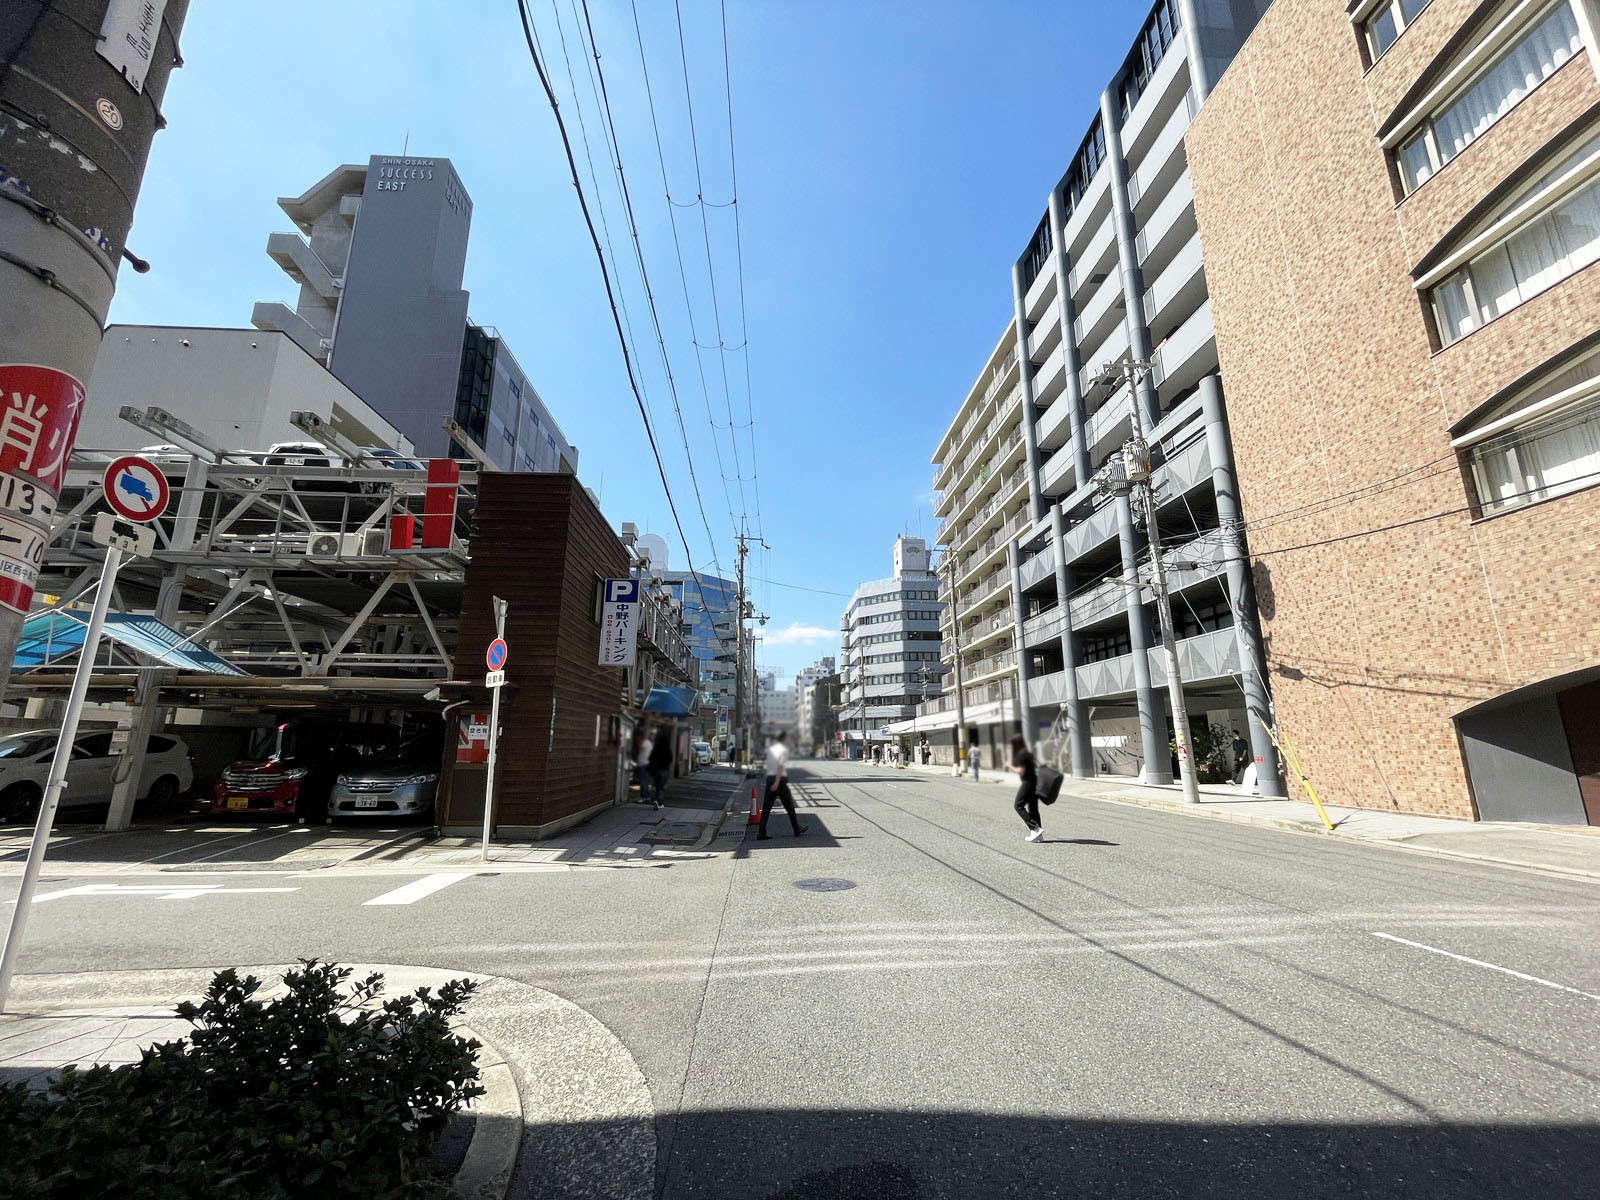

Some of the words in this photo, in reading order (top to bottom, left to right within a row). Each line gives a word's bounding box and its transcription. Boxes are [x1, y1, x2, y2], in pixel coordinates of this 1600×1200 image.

[382, 158, 434, 167] SHIN-OSAKA
[380, 167, 433, 180] SUCCESS
[377, 181, 406, 191] EAST
[610, 581, 633, 602] P
[613, 604, 629, 662] 中野パーキング
